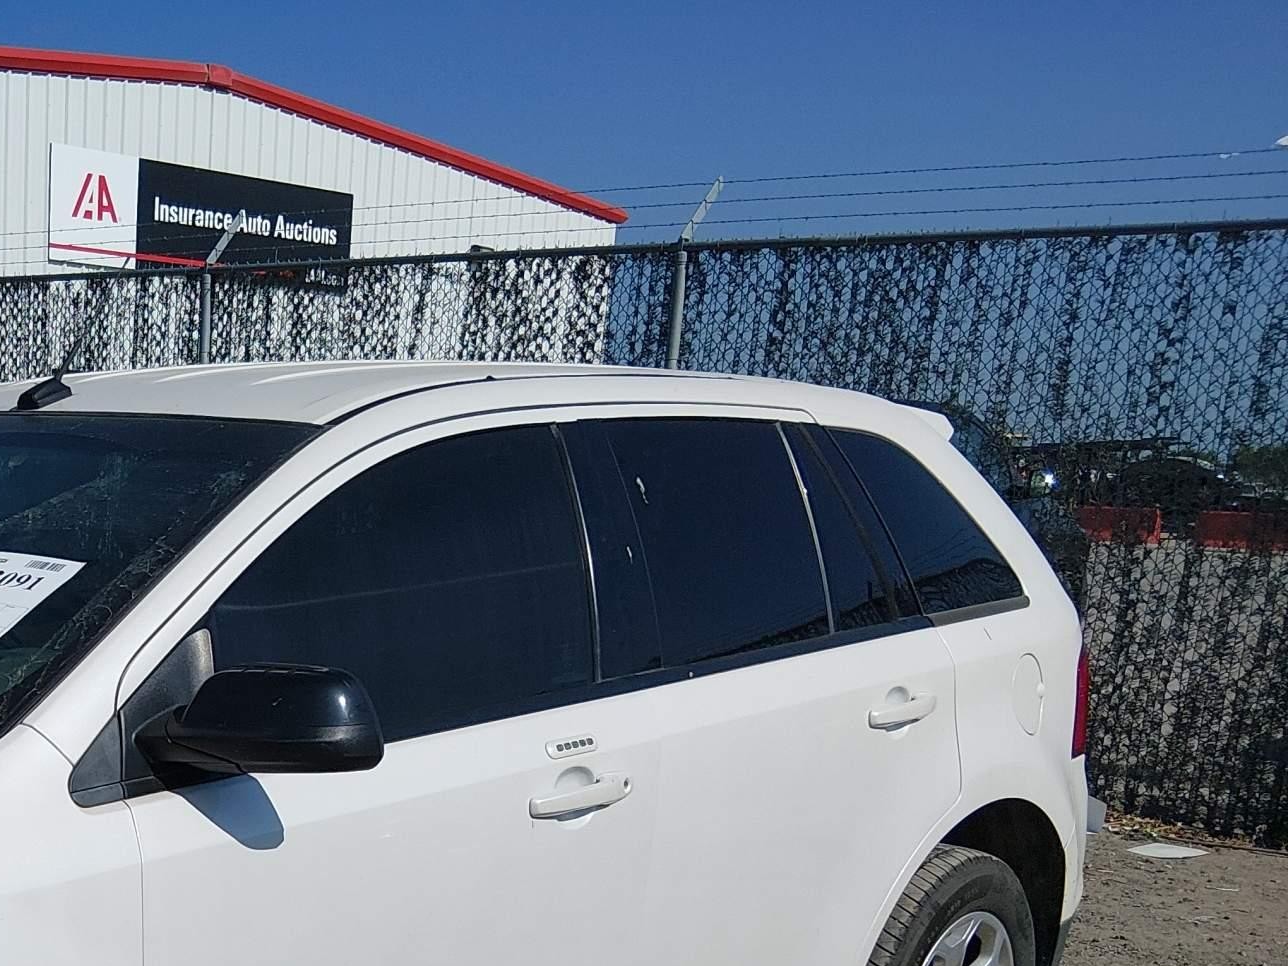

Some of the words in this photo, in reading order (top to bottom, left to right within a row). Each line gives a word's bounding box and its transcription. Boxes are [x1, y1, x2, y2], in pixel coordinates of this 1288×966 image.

[154, 196, 232, 231] Insurance
[237, 209, 271, 237] Auto
[274, 214, 338, 246] Auctions
